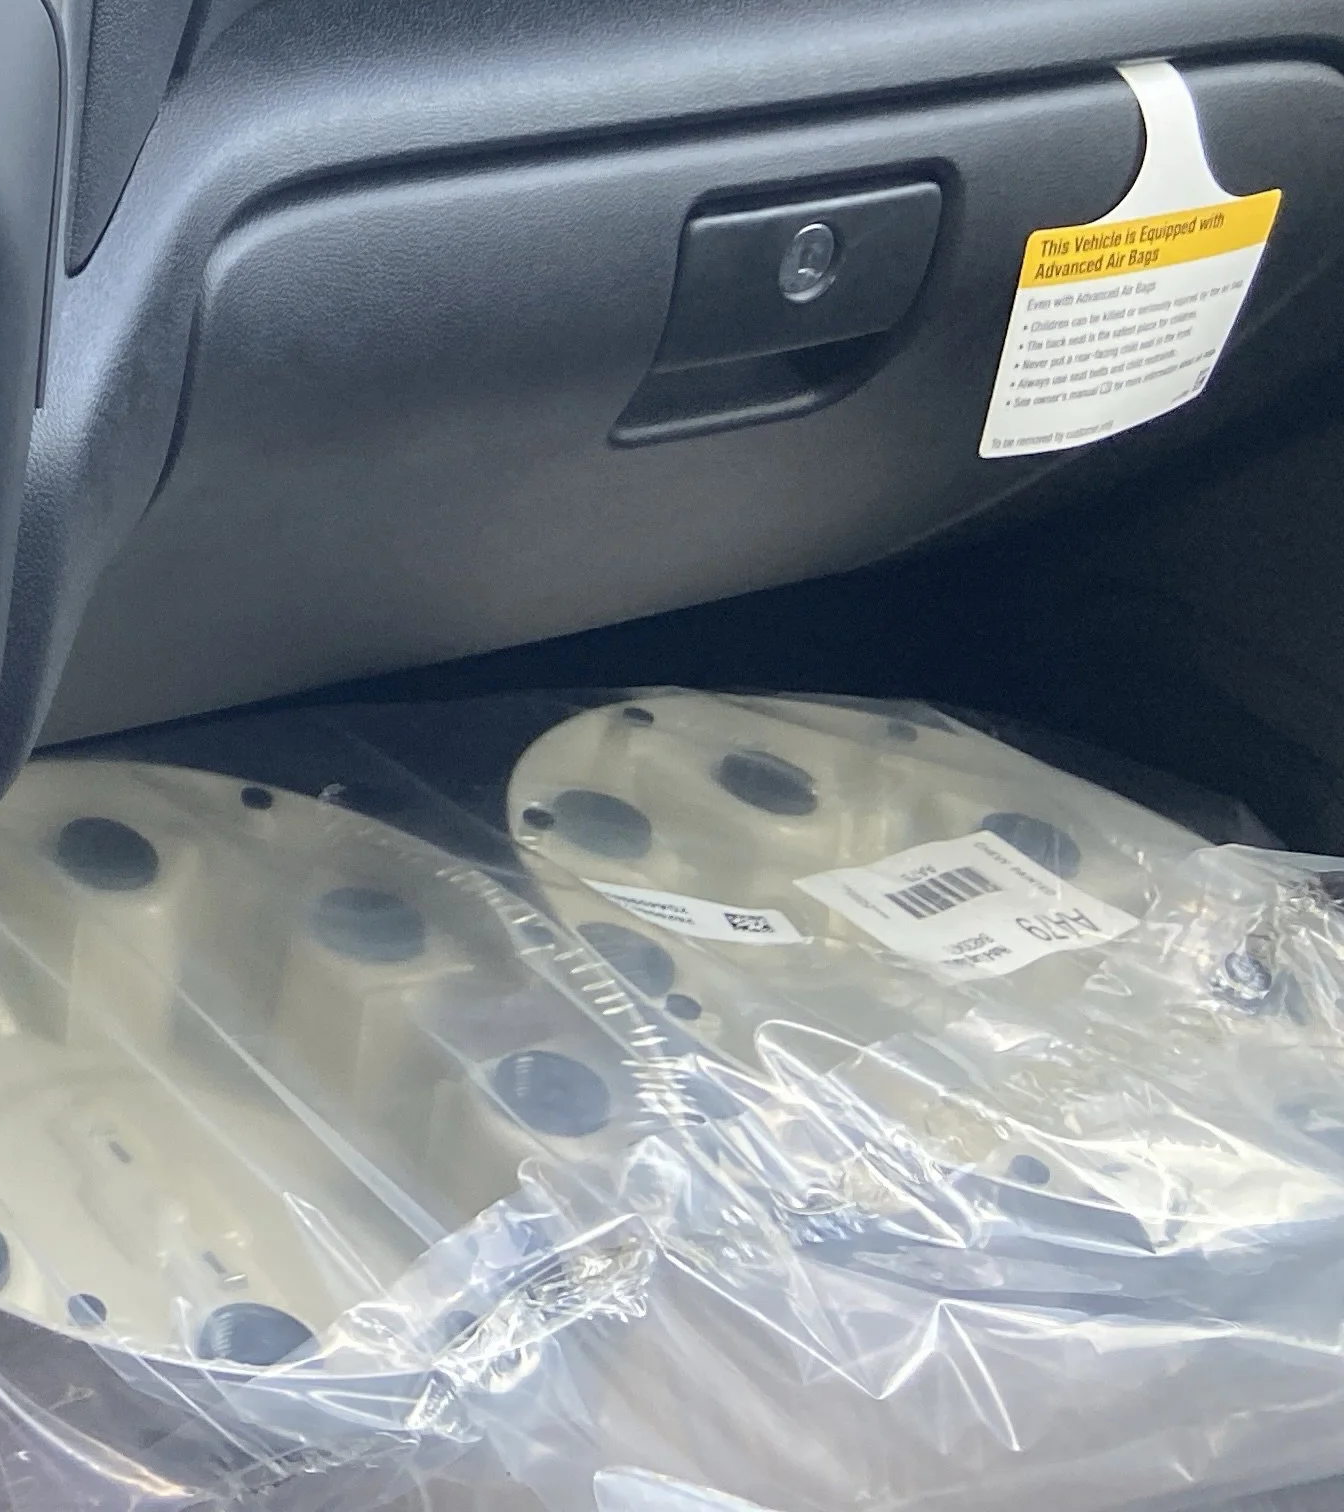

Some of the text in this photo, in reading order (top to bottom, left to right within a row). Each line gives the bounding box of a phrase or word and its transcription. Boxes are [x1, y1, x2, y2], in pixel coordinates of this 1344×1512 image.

[1041, 212, 1225, 258] This Vehicle is Equipped with
[1034, 247, 1160, 280] Advanced Air Bags
